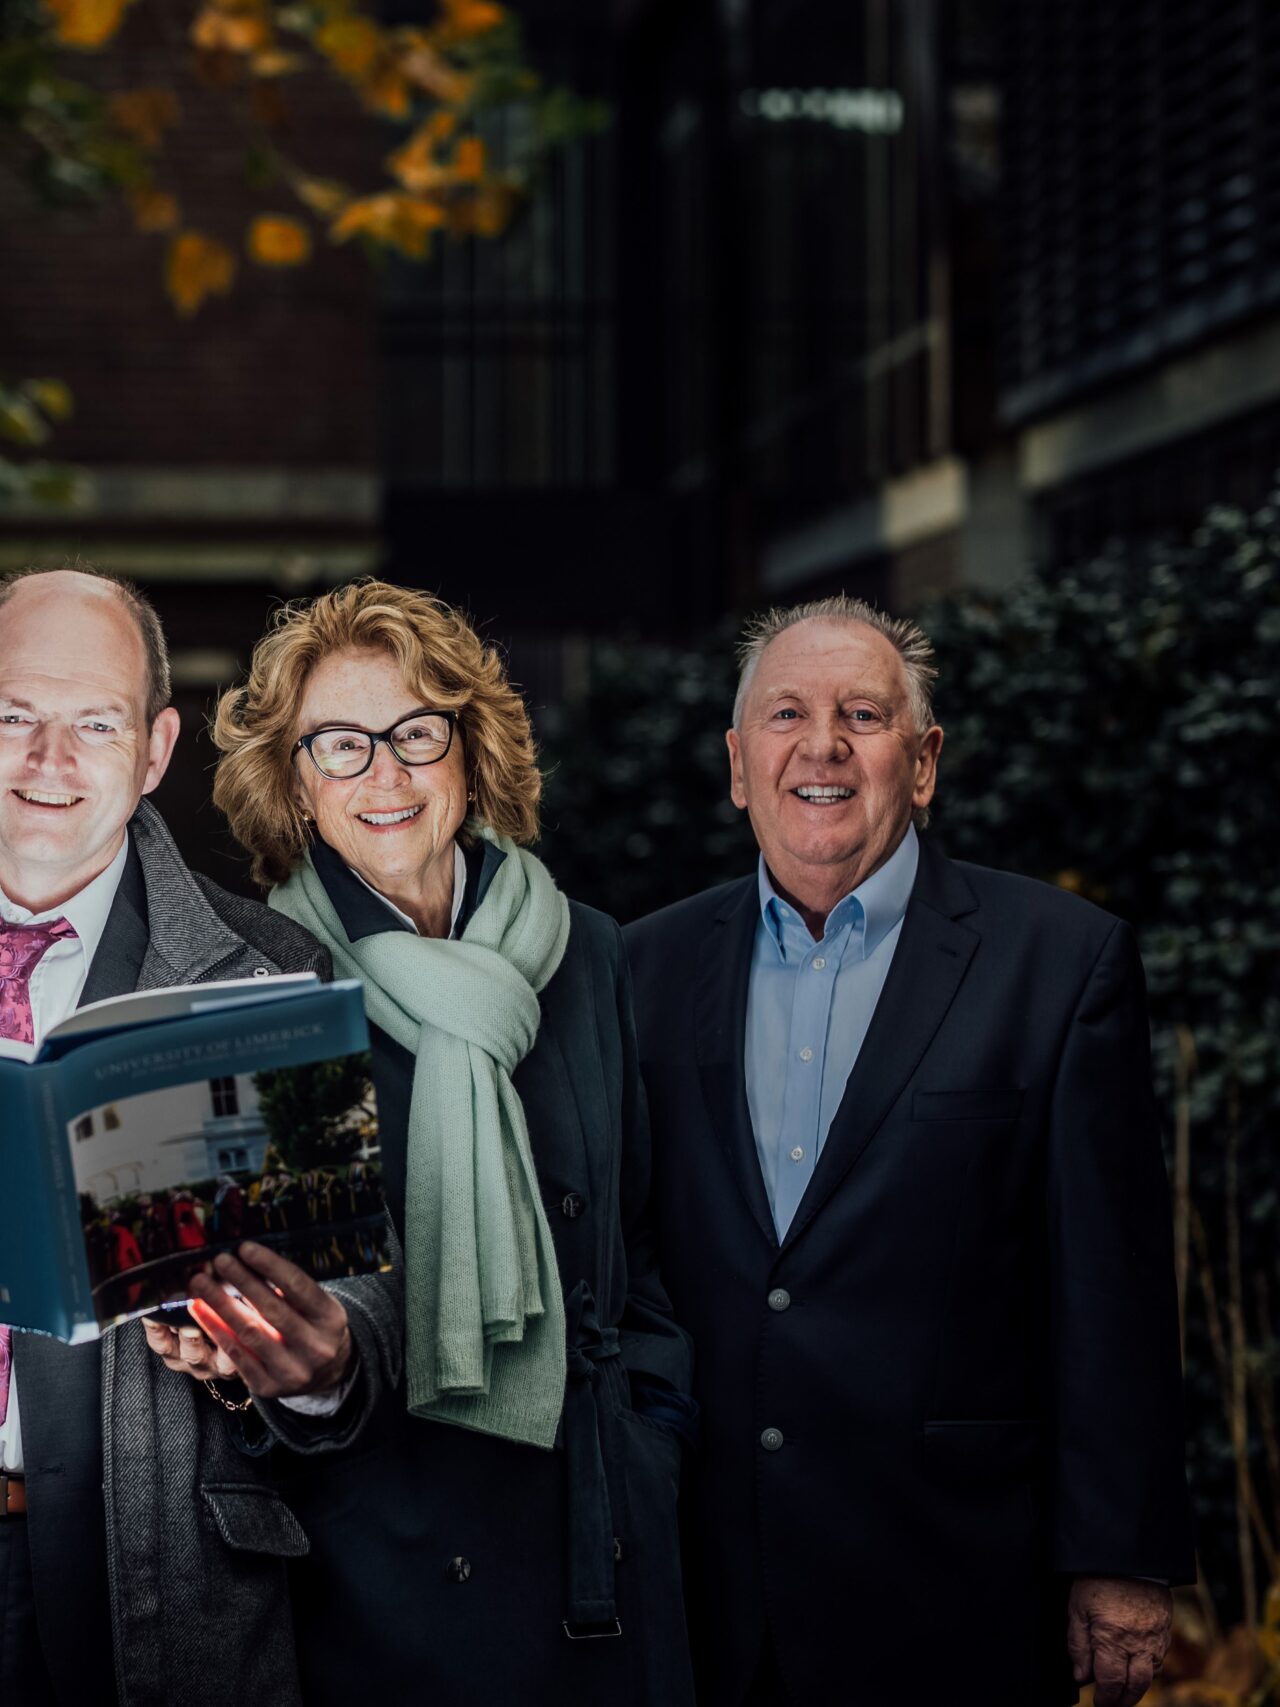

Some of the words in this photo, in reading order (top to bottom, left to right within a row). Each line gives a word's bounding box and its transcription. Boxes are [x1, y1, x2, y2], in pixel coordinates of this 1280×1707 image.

[96, 1045, 203, 1079] UNIVERSITY
[206, 1039, 228, 1053] OF
[234, 1022, 324, 1049] LIMERICK
